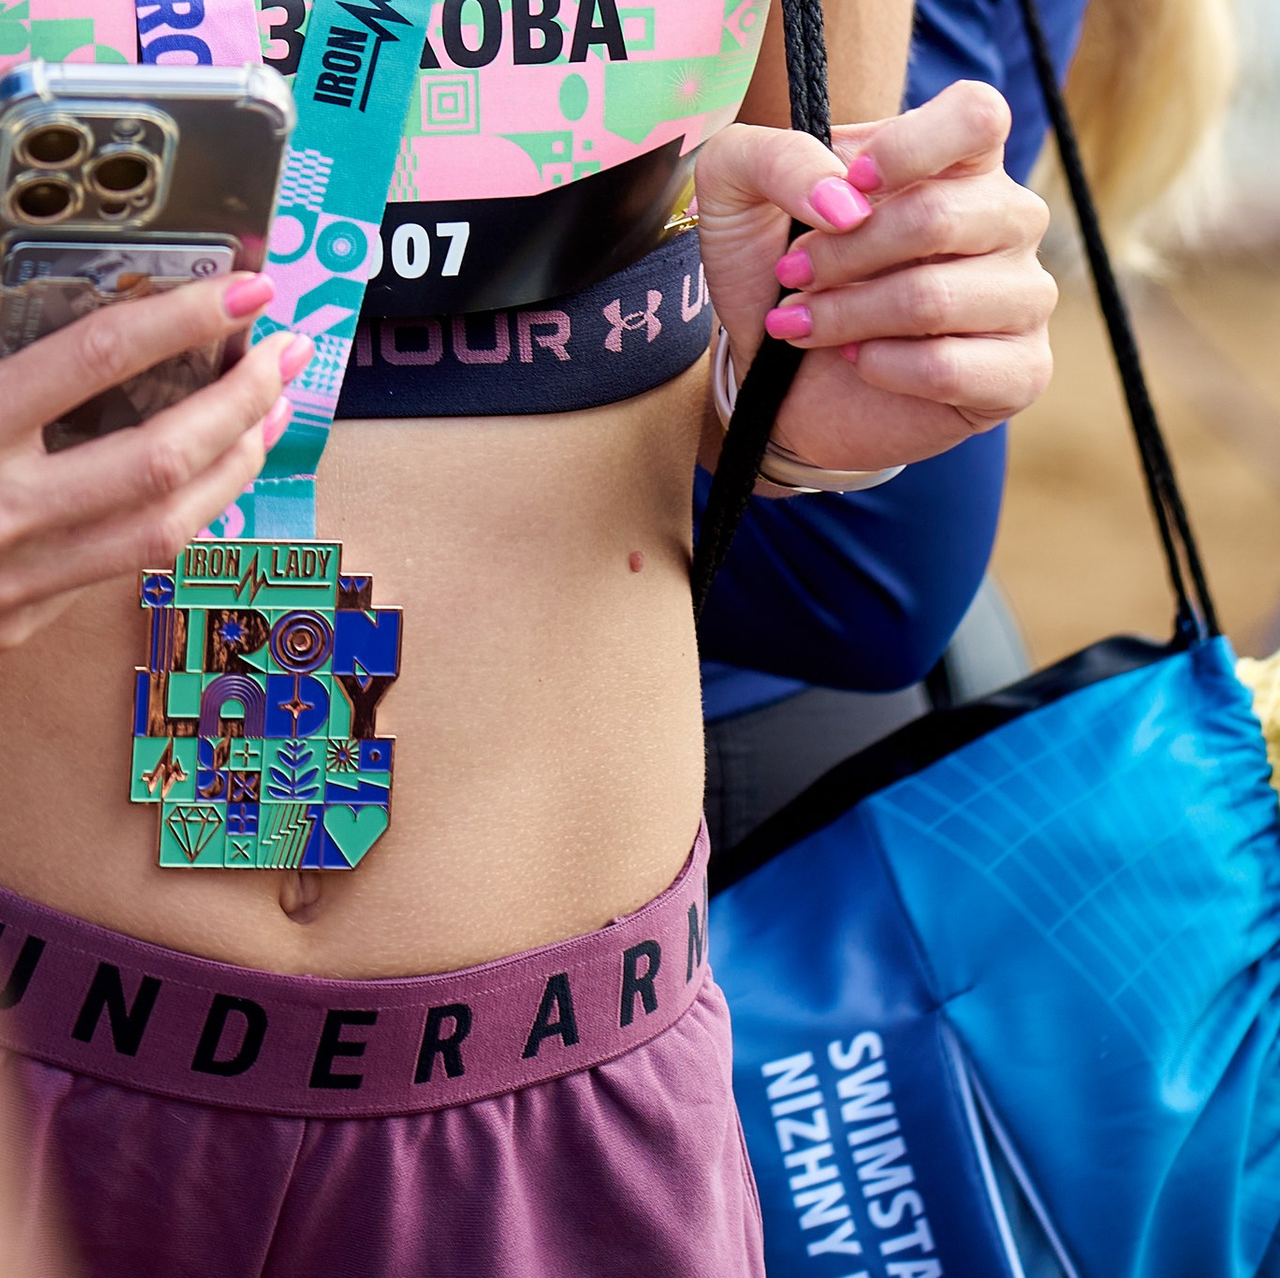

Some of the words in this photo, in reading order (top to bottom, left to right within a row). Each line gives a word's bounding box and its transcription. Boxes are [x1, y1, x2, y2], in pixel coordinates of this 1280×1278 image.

[313, 26, 369, 108] IRON
[368, 221, 471, 280] 07
[184, 545, 242, 578] IRON
[269, 545, 334, 579] LADY
[761, 1050, 864, 1257] NIZHNY
